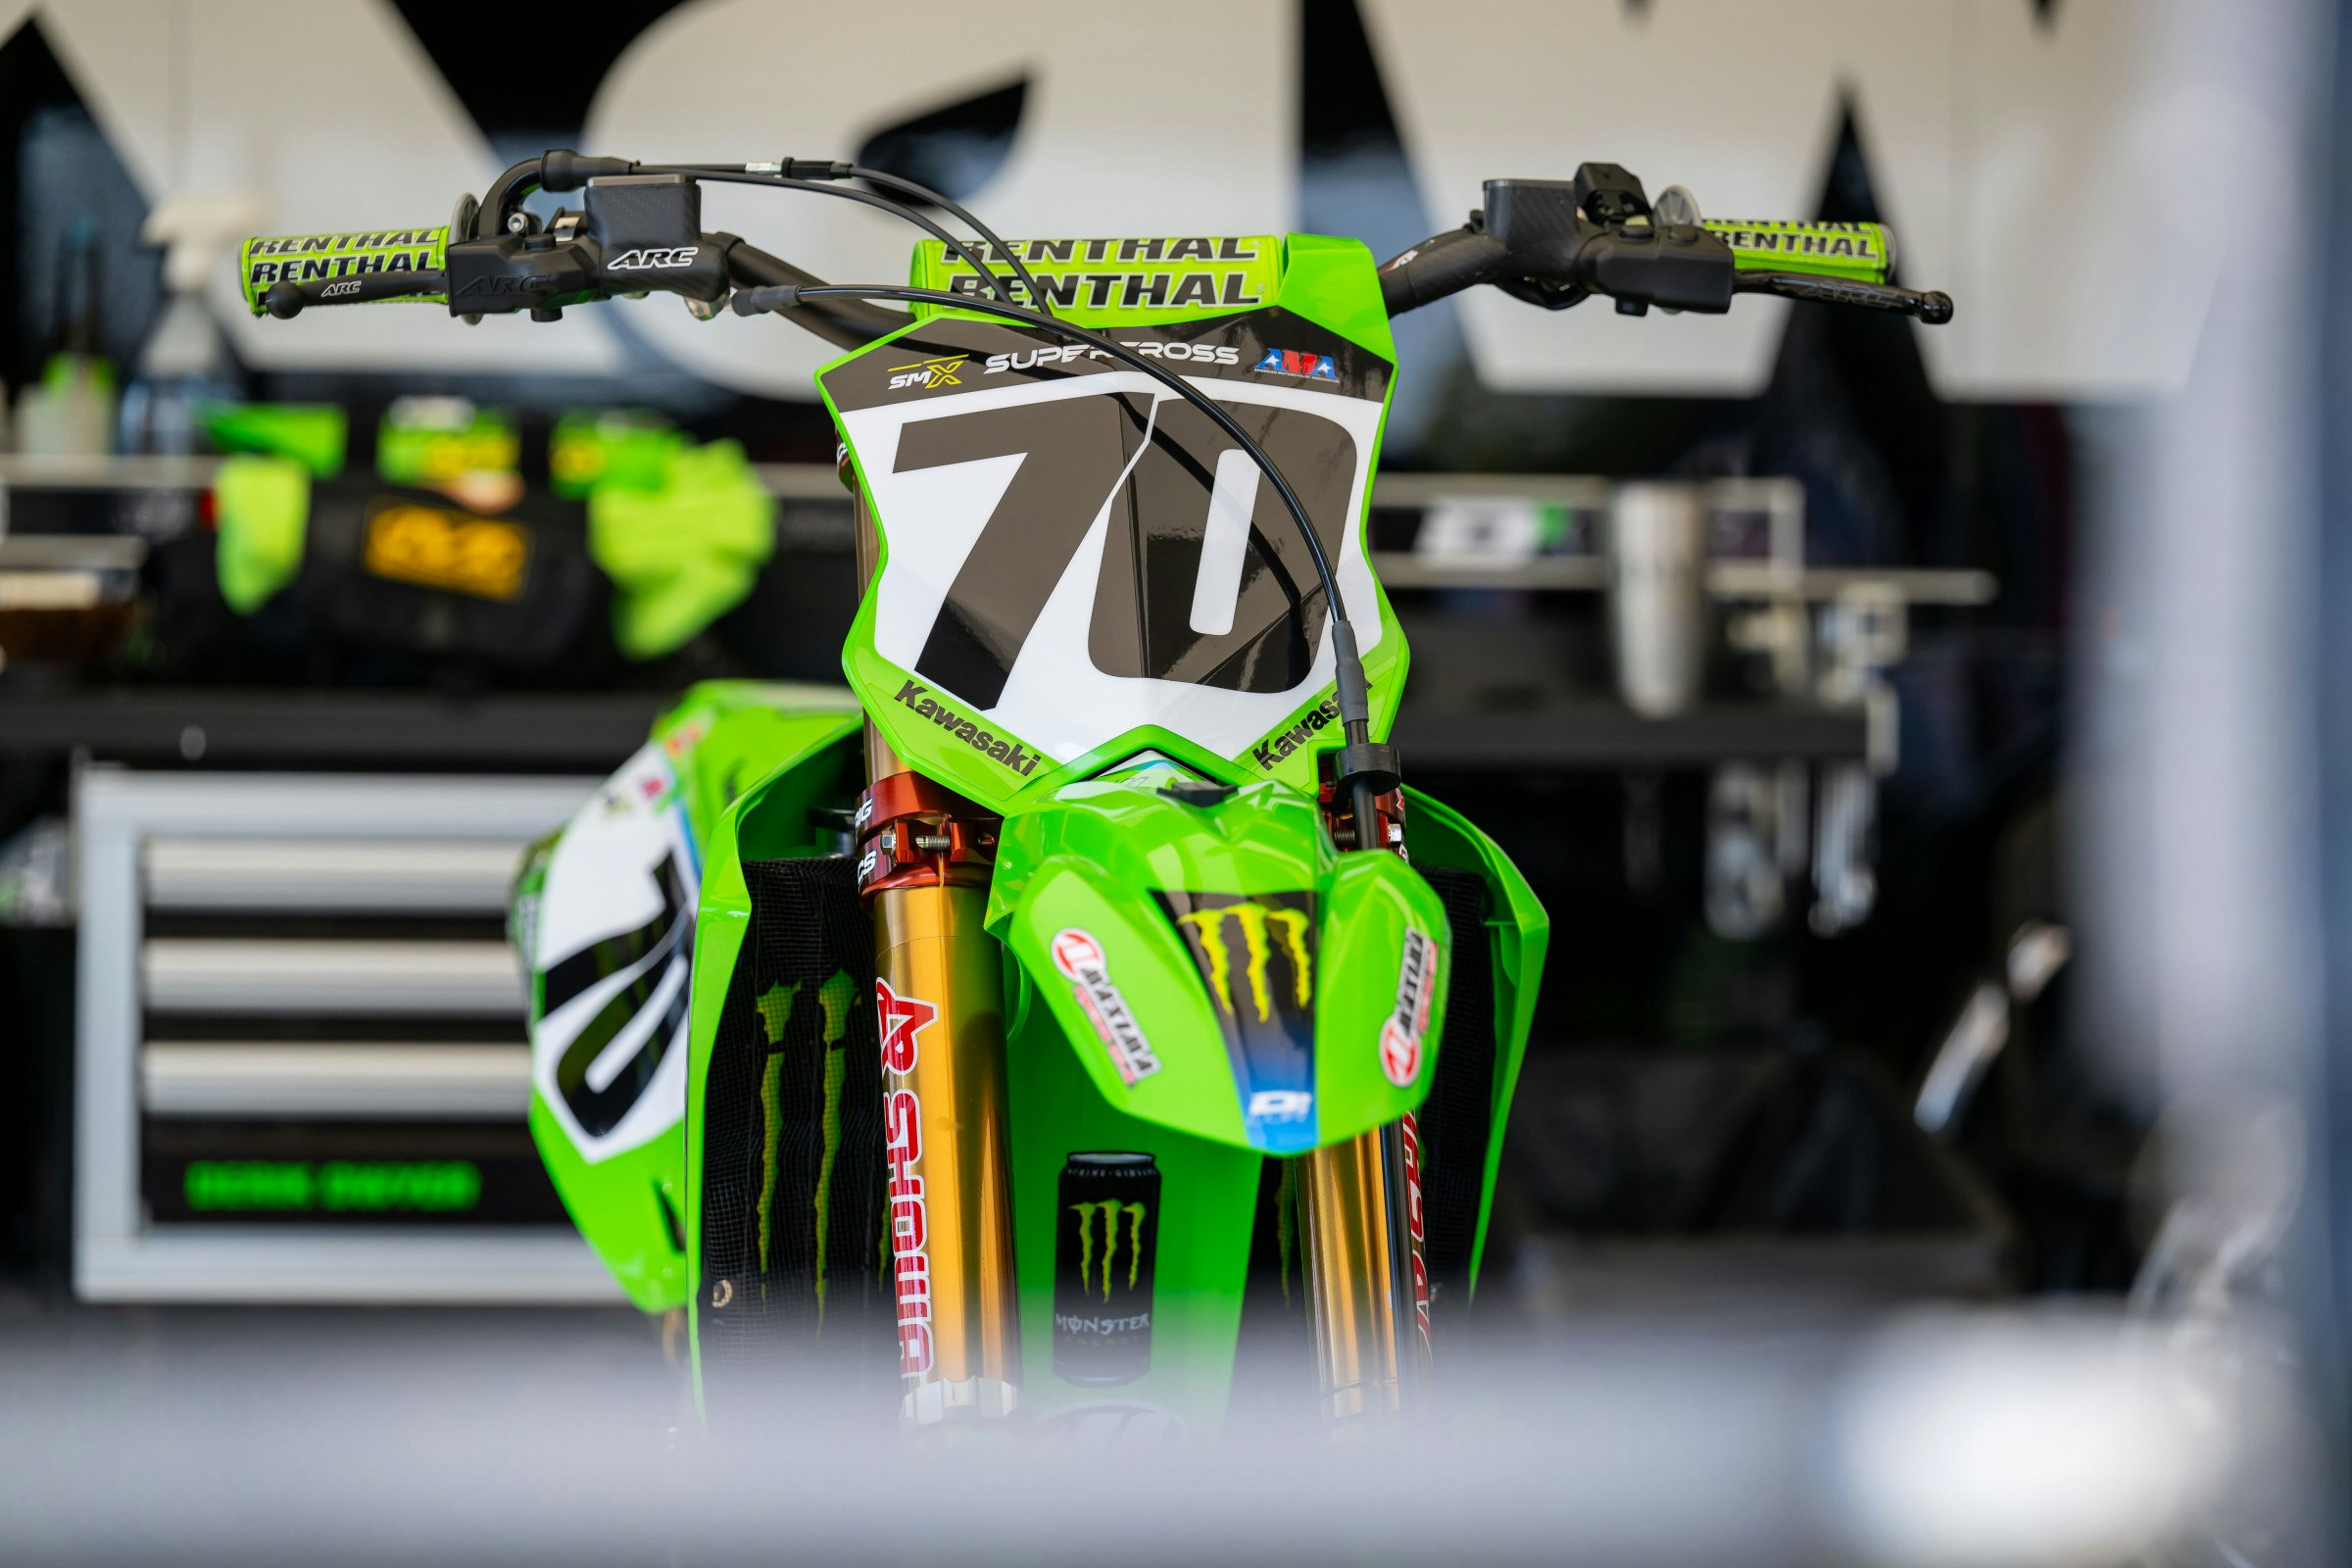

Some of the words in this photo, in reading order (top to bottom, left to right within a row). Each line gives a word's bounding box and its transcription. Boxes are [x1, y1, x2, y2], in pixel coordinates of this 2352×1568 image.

[250, 231, 440, 257] RENTHAL
[607, 247, 699, 270] ARC
[250, 250, 440, 287] RENTHAL
[320, 280, 362, 297] ARC
[946, 272, 1262, 309] RENTHAL
[887, 360, 963, 390] SMX
[1253, 347, 1340, 379] AMA
[892, 391, 1359, 712] 70
[894, 679, 1042, 777] Kawasaki
[883, 1088, 934, 1379] SHOWA
[1055, 1312, 1150, 1336] MONSTER
